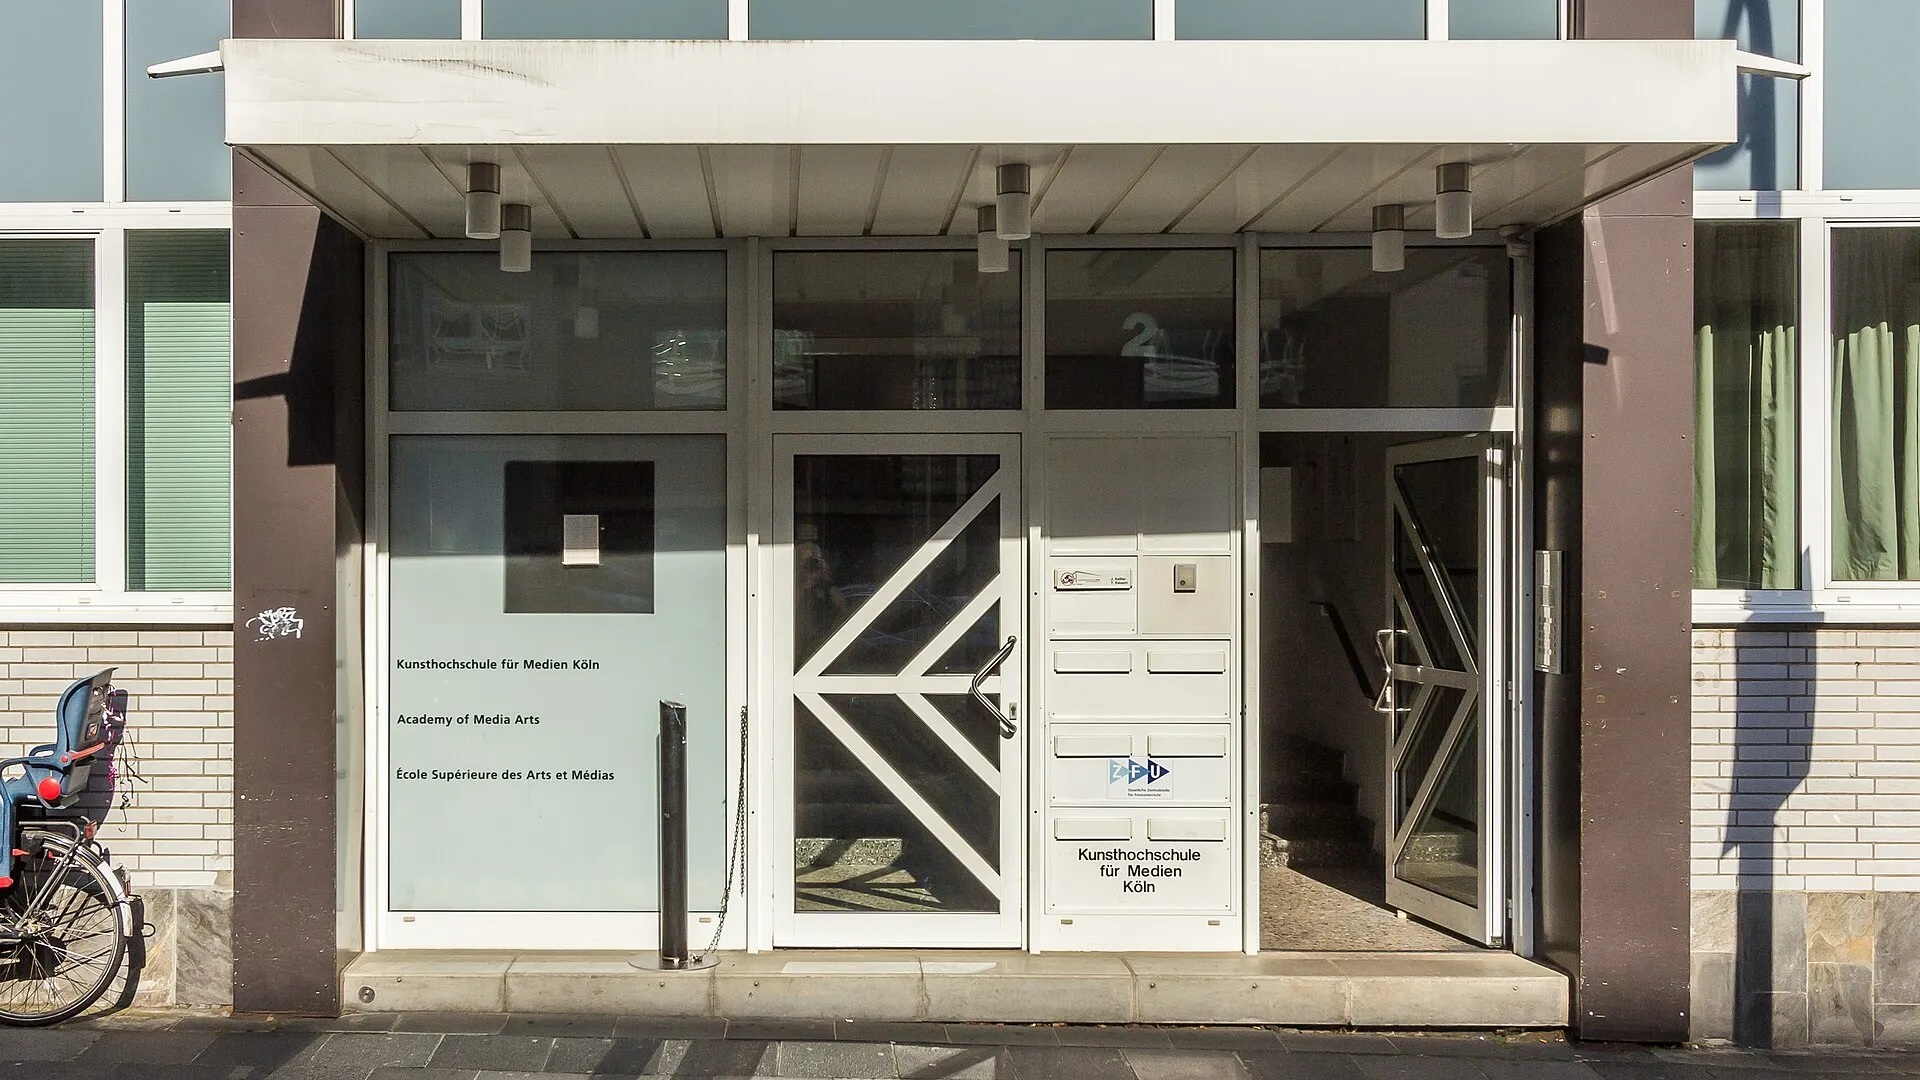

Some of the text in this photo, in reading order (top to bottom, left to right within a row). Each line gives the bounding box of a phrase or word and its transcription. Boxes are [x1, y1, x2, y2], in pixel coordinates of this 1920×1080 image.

[1121, 312, 1157, 358] 2
[396, 658, 600, 670] Kunsthochschule für Medien Köln
[397, 713, 540, 727] Academy of Media Arts
[396, 767, 615, 782] École Supérieure des Arts et Médias
[1078, 848, 1201, 861] Kunsthochschule
[1099, 864, 1182, 877] für Medien
[1123, 880, 1156, 893] Köln
